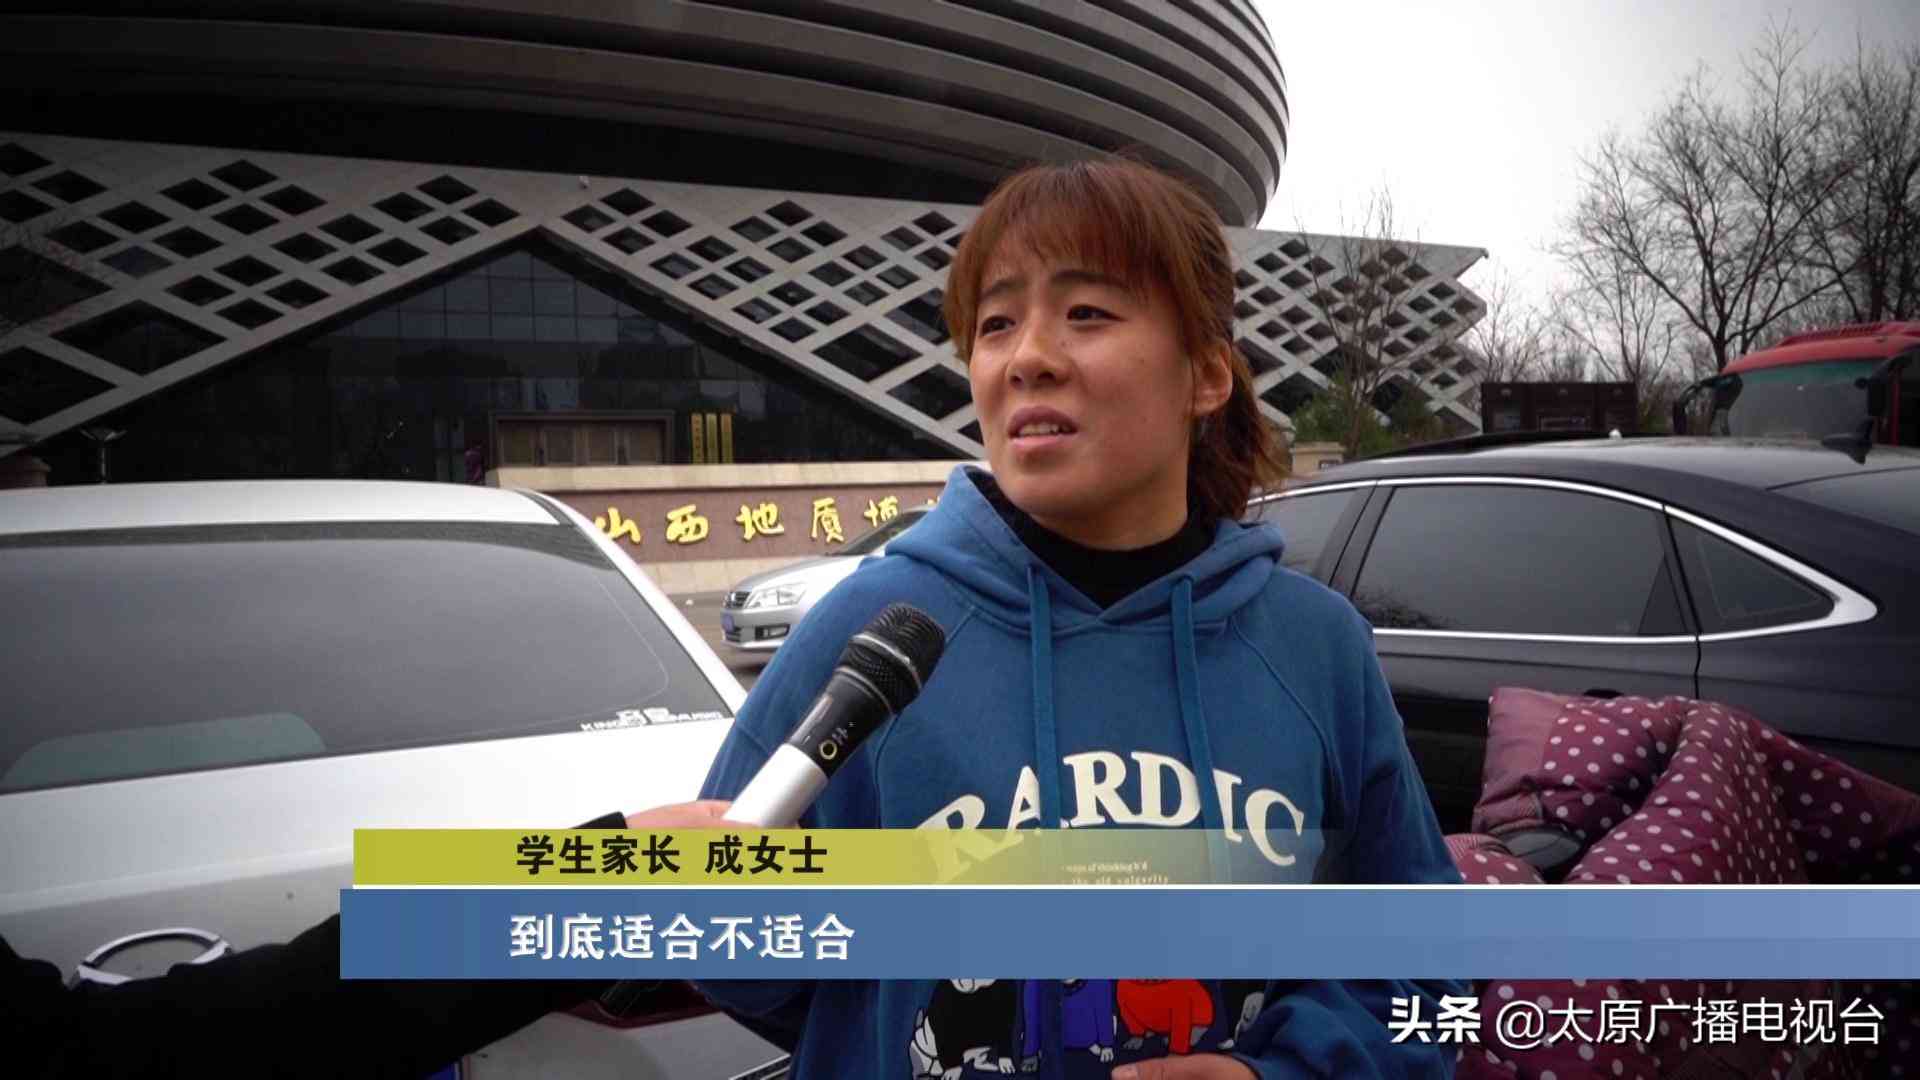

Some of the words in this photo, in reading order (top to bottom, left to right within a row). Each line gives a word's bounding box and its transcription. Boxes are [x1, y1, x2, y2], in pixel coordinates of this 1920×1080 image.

[595, 495, 940, 546] 山西地质博
